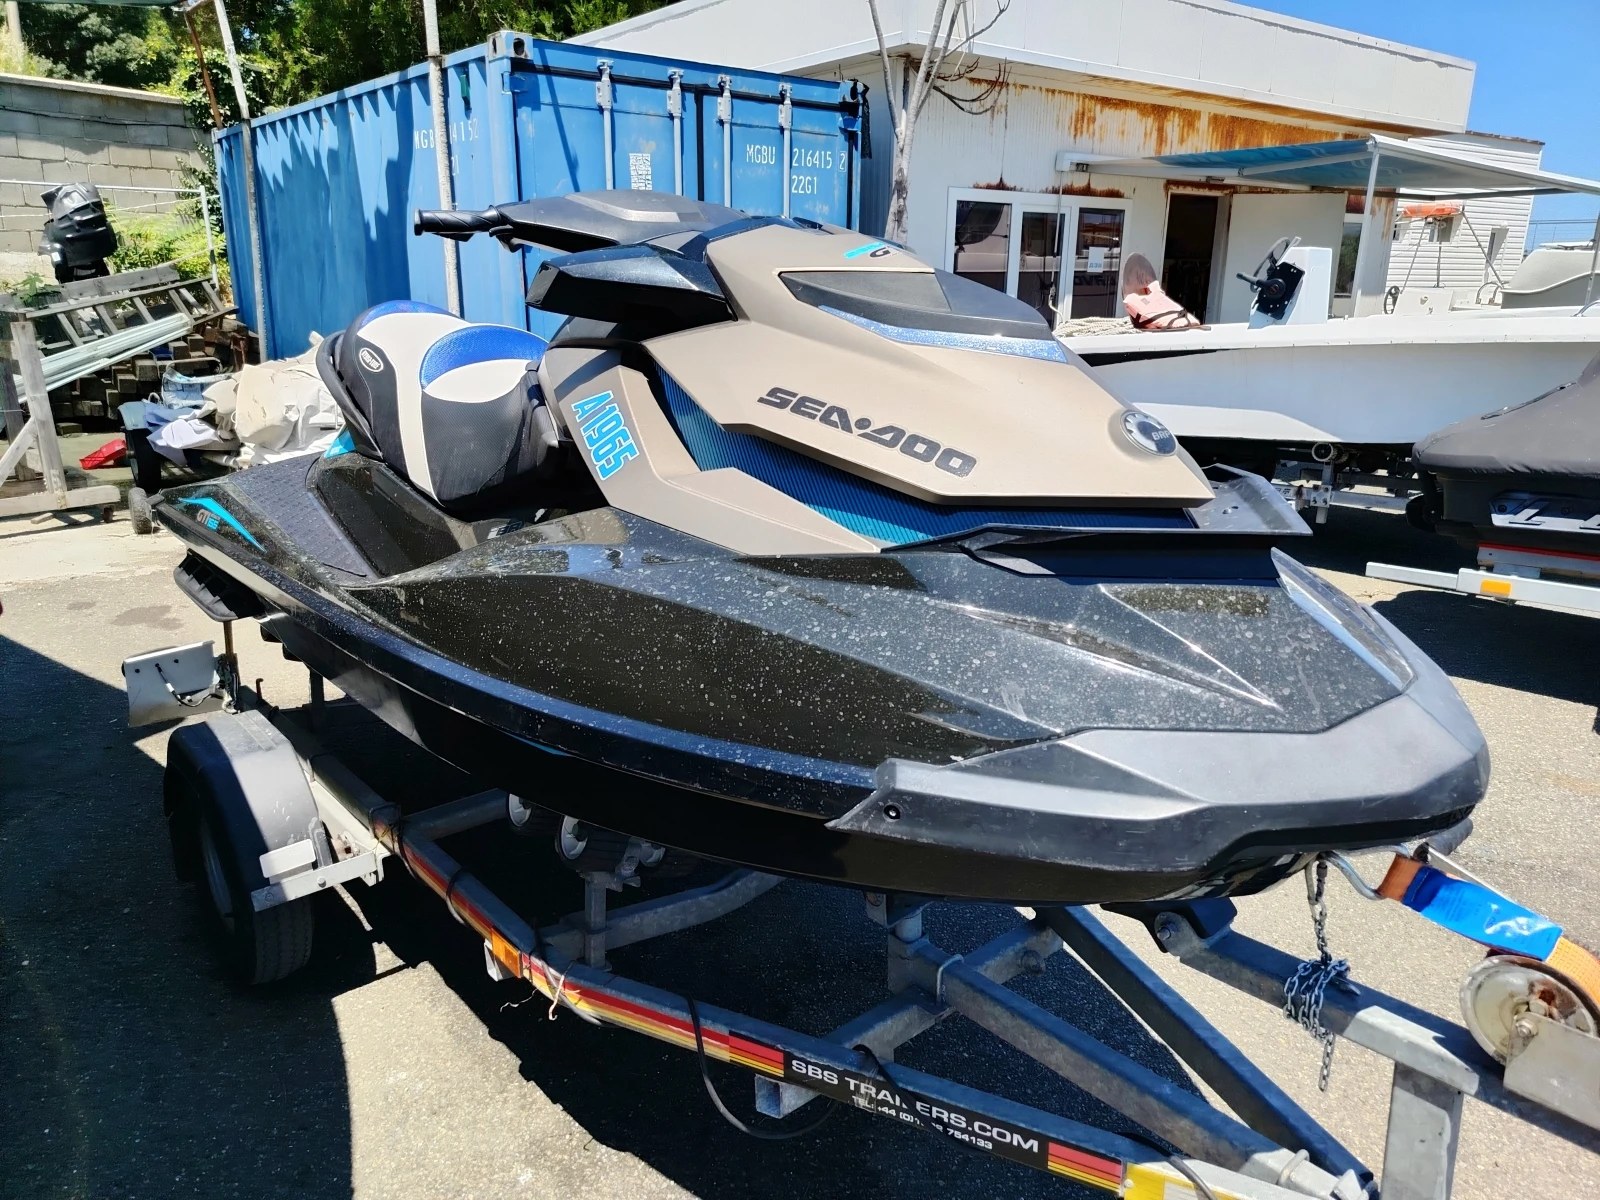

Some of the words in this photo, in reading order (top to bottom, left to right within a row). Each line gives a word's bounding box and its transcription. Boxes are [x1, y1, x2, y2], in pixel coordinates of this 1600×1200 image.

[414, 129, 436, 150] MGB
[746, 143, 776, 165] MGBU
[792, 148, 833, 169] 216415
[839, 152, 846, 171] 2
[791, 174, 817, 195] 22G1
[571, 390, 640, 480] A1965
[1151, 430, 1171, 441] BRP
[791, 1058, 839, 1085] SBS
[845, 1076, 1039, 1153] TRAIERS.COM
[851, 1095, 874, 1109] TEL:
[877, 1105, 896, 1116] +44
[946, 1128, 993, 1150] 754133
